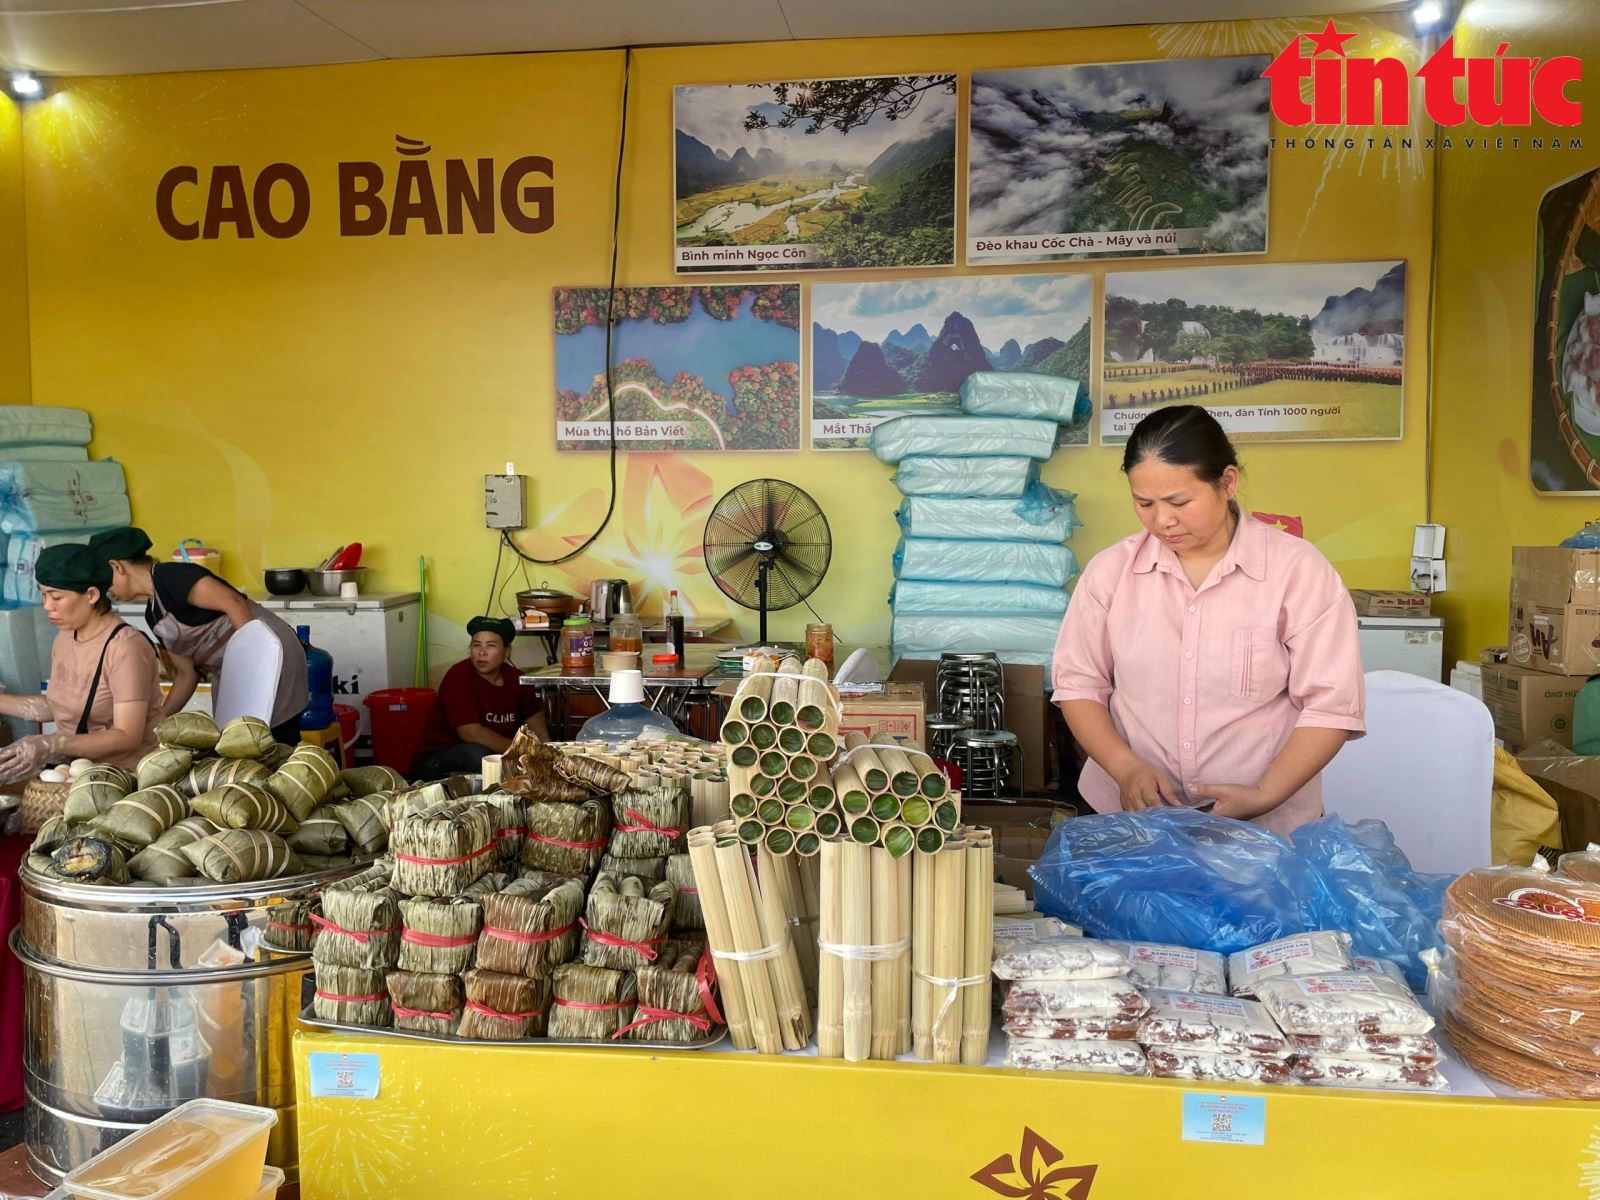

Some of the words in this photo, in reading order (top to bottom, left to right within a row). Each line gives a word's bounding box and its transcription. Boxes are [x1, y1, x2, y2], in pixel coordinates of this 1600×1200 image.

[156, 163, 310, 241] CAO
[338, 133, 554, 237] BẰNG
[976, 240, 1002, 251] Đèo
[1006, 239, 1037, 250] khau
[1042, 236, 1066, 248] Cốc
[1069, 237, 1094, 247] Chà
[1106, 235, 1133, 247] Mây
[1137, 233, 1152, 244] và
[1155, 232, 1176, 244] núi
[682, 250, 709, 261] Bình
[713, 249, 744, 260] minh
[748, 249, 779, 261] Ngọc
[782, 248, 806, 258] Côn
[1114, 411, 1147, 420] Chươn
[1235, 408, 1255, 417] đàn
[1257, 407, 1280, 417] Tính
[1283, 407, 1307, 416] 1000
[1310, 406, 1341, 417] người
[565, 426, 590, 436] Mùa
[593, 426, 612, 436] thu
[1113, 422, 1127, 431] tại
[332, 674, 360, 694] ki
